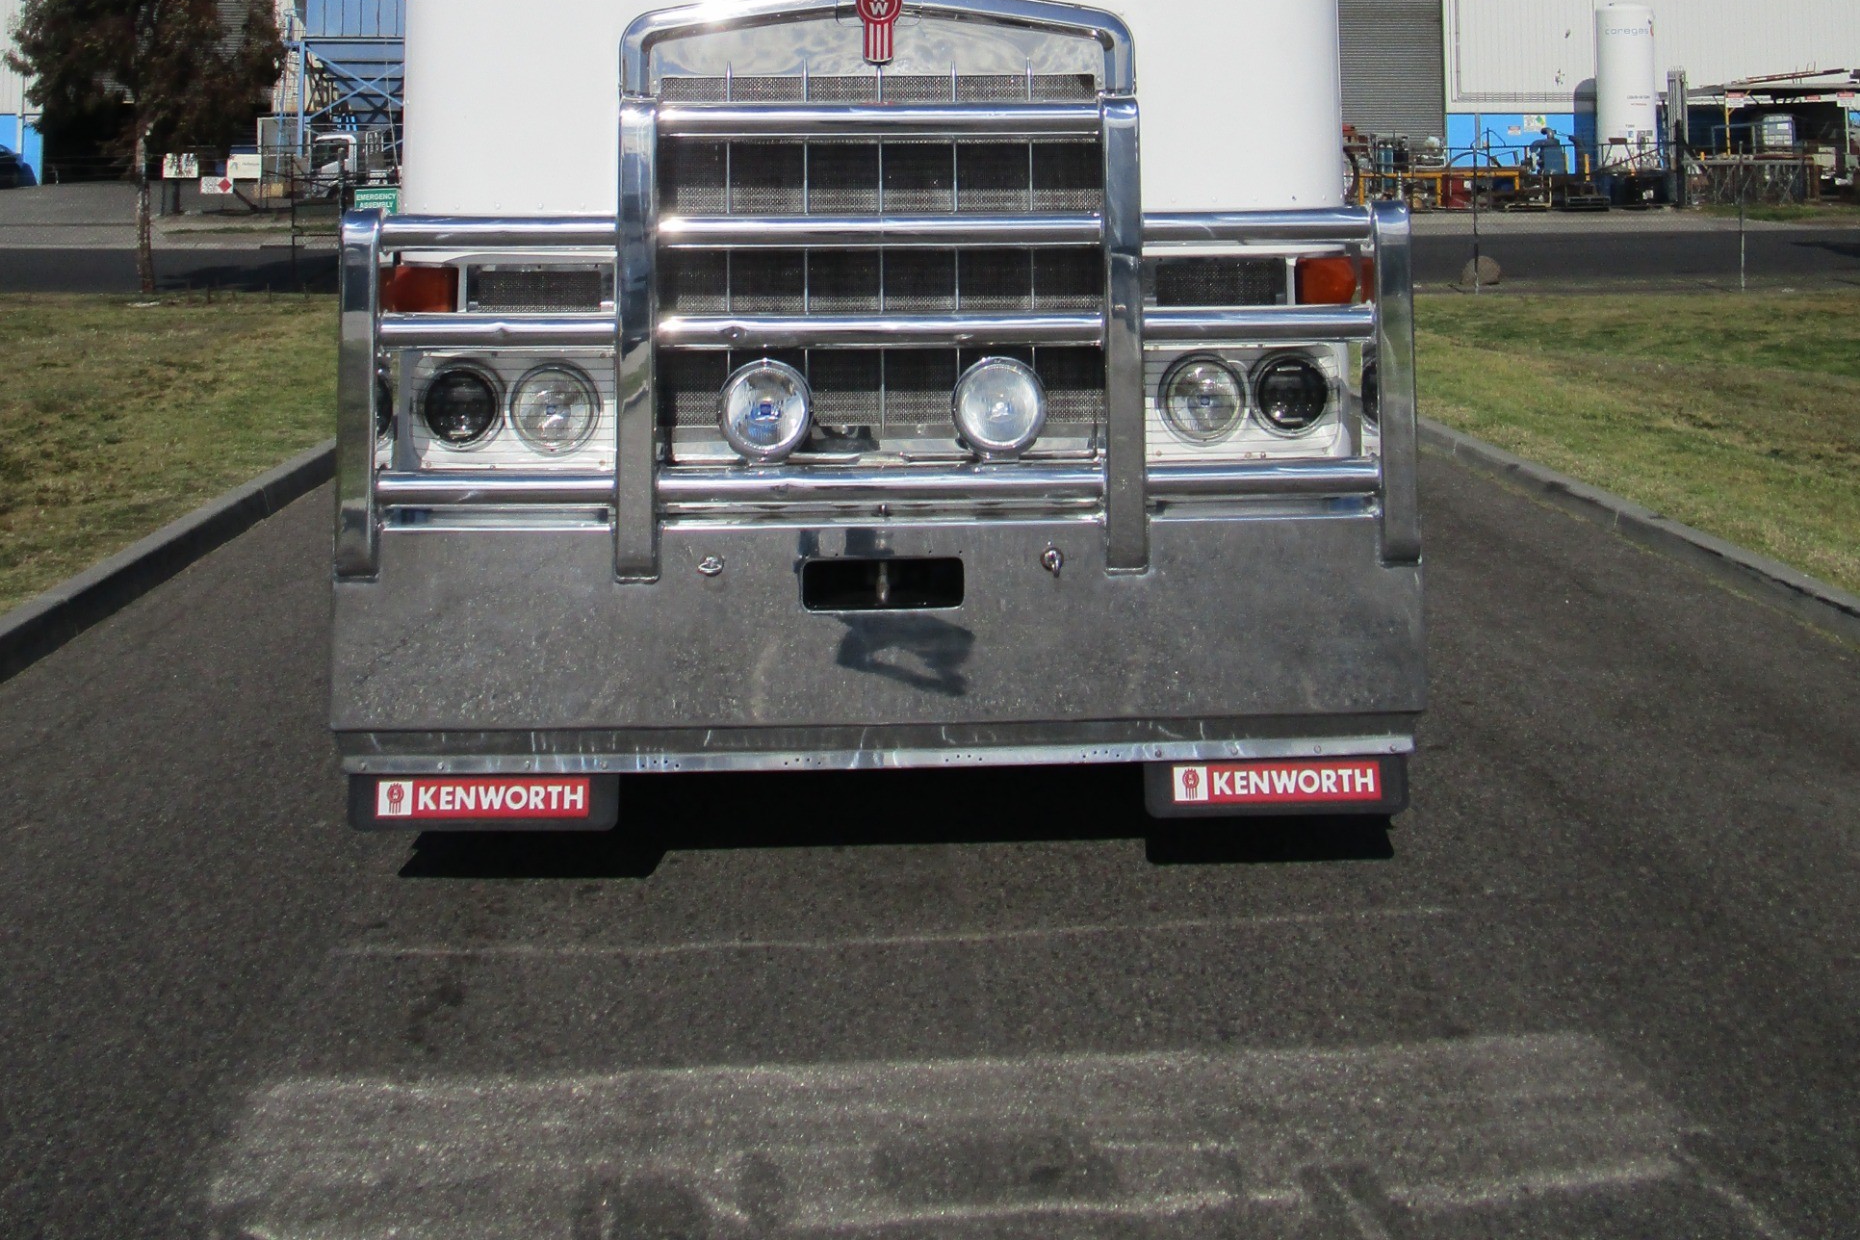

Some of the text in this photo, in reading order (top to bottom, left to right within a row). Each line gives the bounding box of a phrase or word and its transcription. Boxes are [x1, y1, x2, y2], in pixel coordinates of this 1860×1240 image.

[869, 1, 889, 16] W
[1604, 28, 1649, 36] coregas
[356, 193, 396, 201] EMERGENCY
[359, 201, 394, 209] ASSEMBLY
[1212, 768, 1375, 796] KENWORTH
[417, 785, 584, 810] KENWORTH
